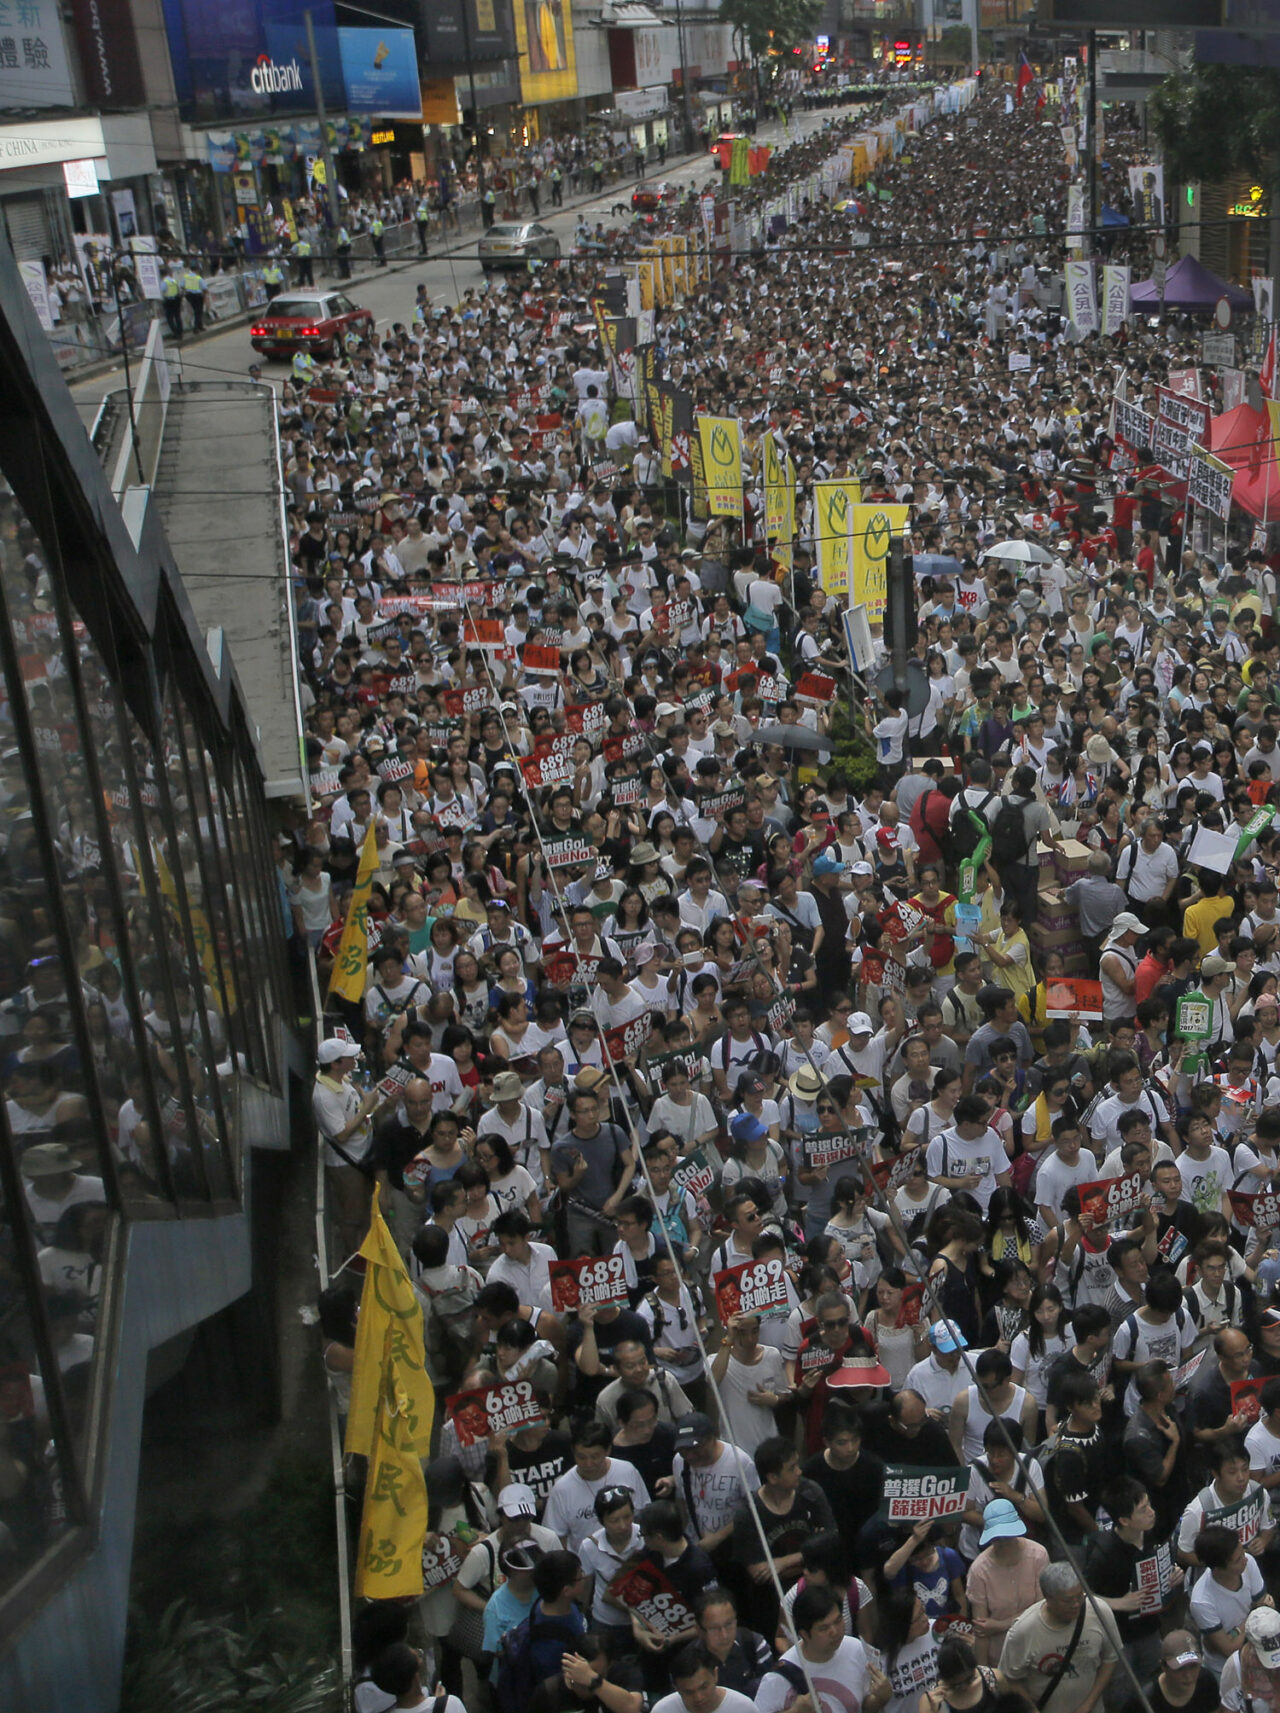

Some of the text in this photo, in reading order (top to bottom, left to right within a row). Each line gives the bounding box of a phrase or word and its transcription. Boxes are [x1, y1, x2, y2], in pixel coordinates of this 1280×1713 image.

[251, 54, 303, 93] citibank
[463, 686, 487, 704] 689
[583, 702, 604, 722] 689
[552, 734, 576, 751] 689
[539, 752, 564, 771] 689
[439, 803, 461, 827] 689
[624, 1012, 651, 1043] 689
[1108, 1173, 1140, 1204] 689
[578, 1256, 623, 1287] 689
[740, 1259, 783, 1293] 689
[578, 1279, 628, 1305] 快啲走
[739, 1281, 787, 1312] 快啲走
[485, 1380, 533, 1415] 689
[487, 1400, 541, 1432] 快啲走
[883, 1474, 957, 1498] 普選Go!
[891, 1492, 966, 1517] 篩選No!
[652, 1592, 697, 1631] 689
